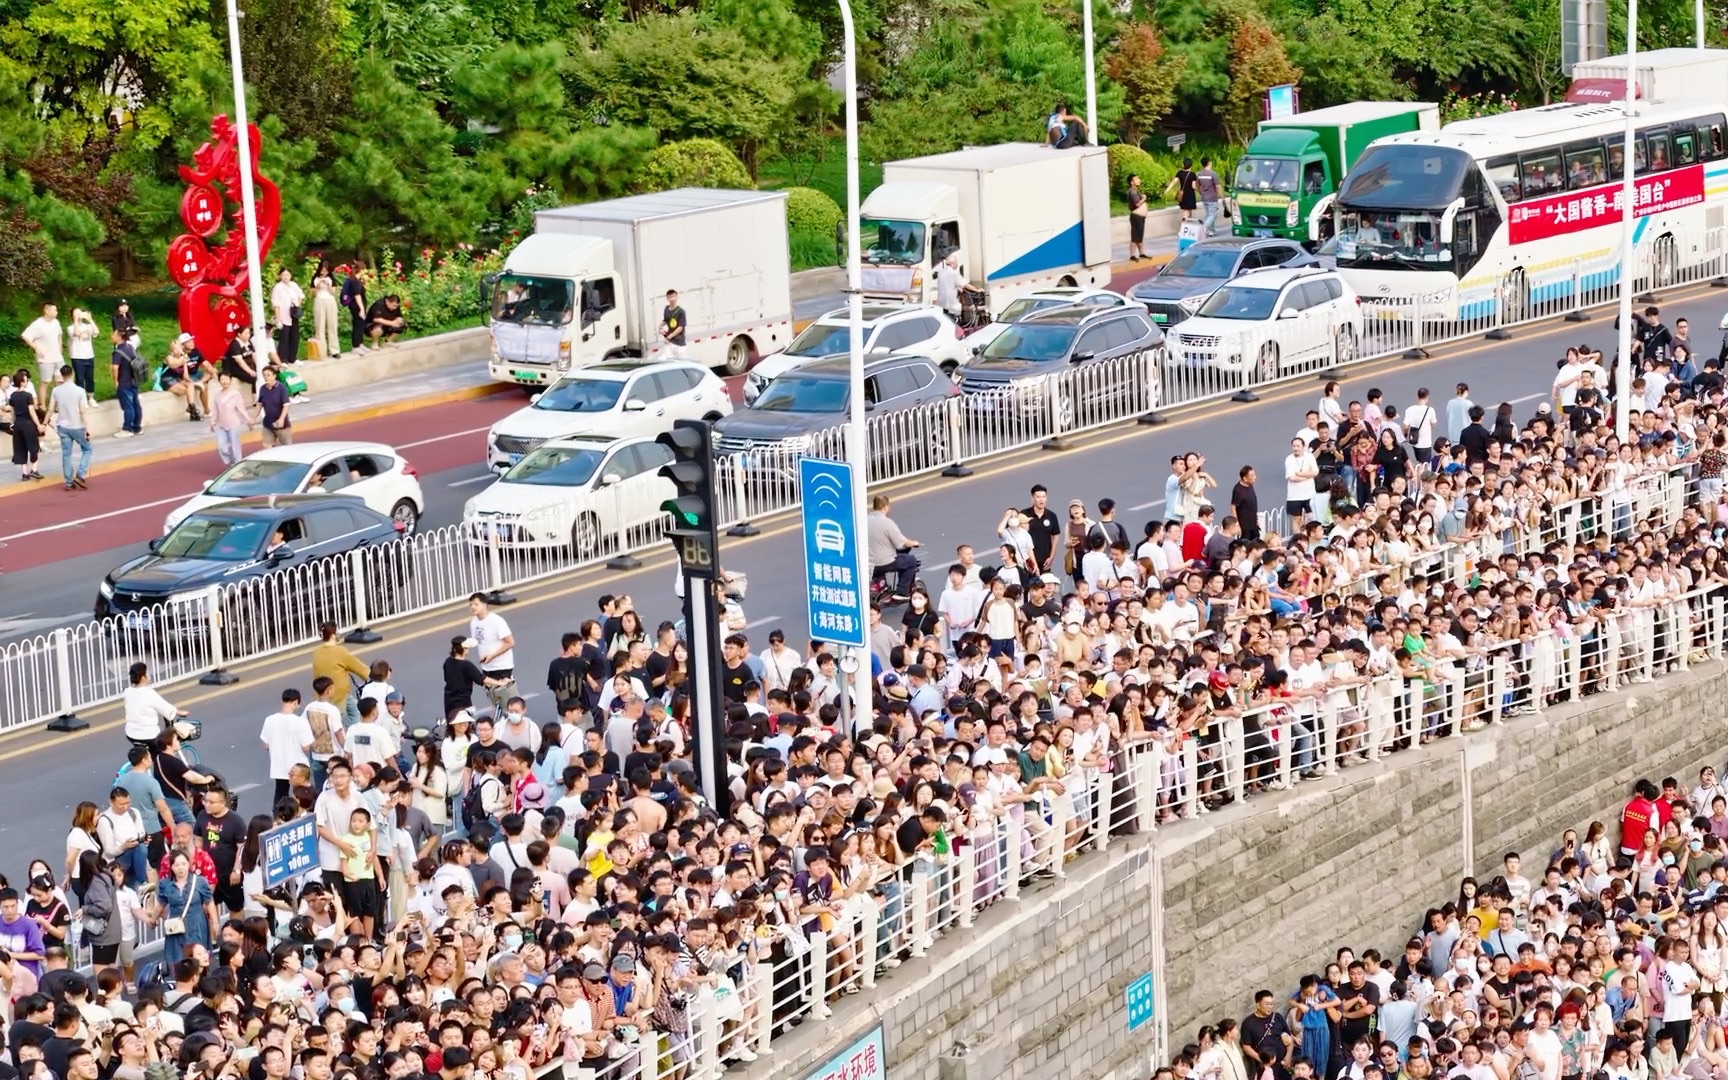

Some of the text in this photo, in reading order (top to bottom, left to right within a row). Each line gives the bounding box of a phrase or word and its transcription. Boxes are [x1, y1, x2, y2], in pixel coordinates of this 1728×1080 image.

[813, 561, 852, 585] 智能网联
[811, 584, 857, 609] 开放测试道路
[281, 822, 313, 847] 公共厕所
[289, 840, 304, 856] WC
[288, 854, 310, 871] 100m
